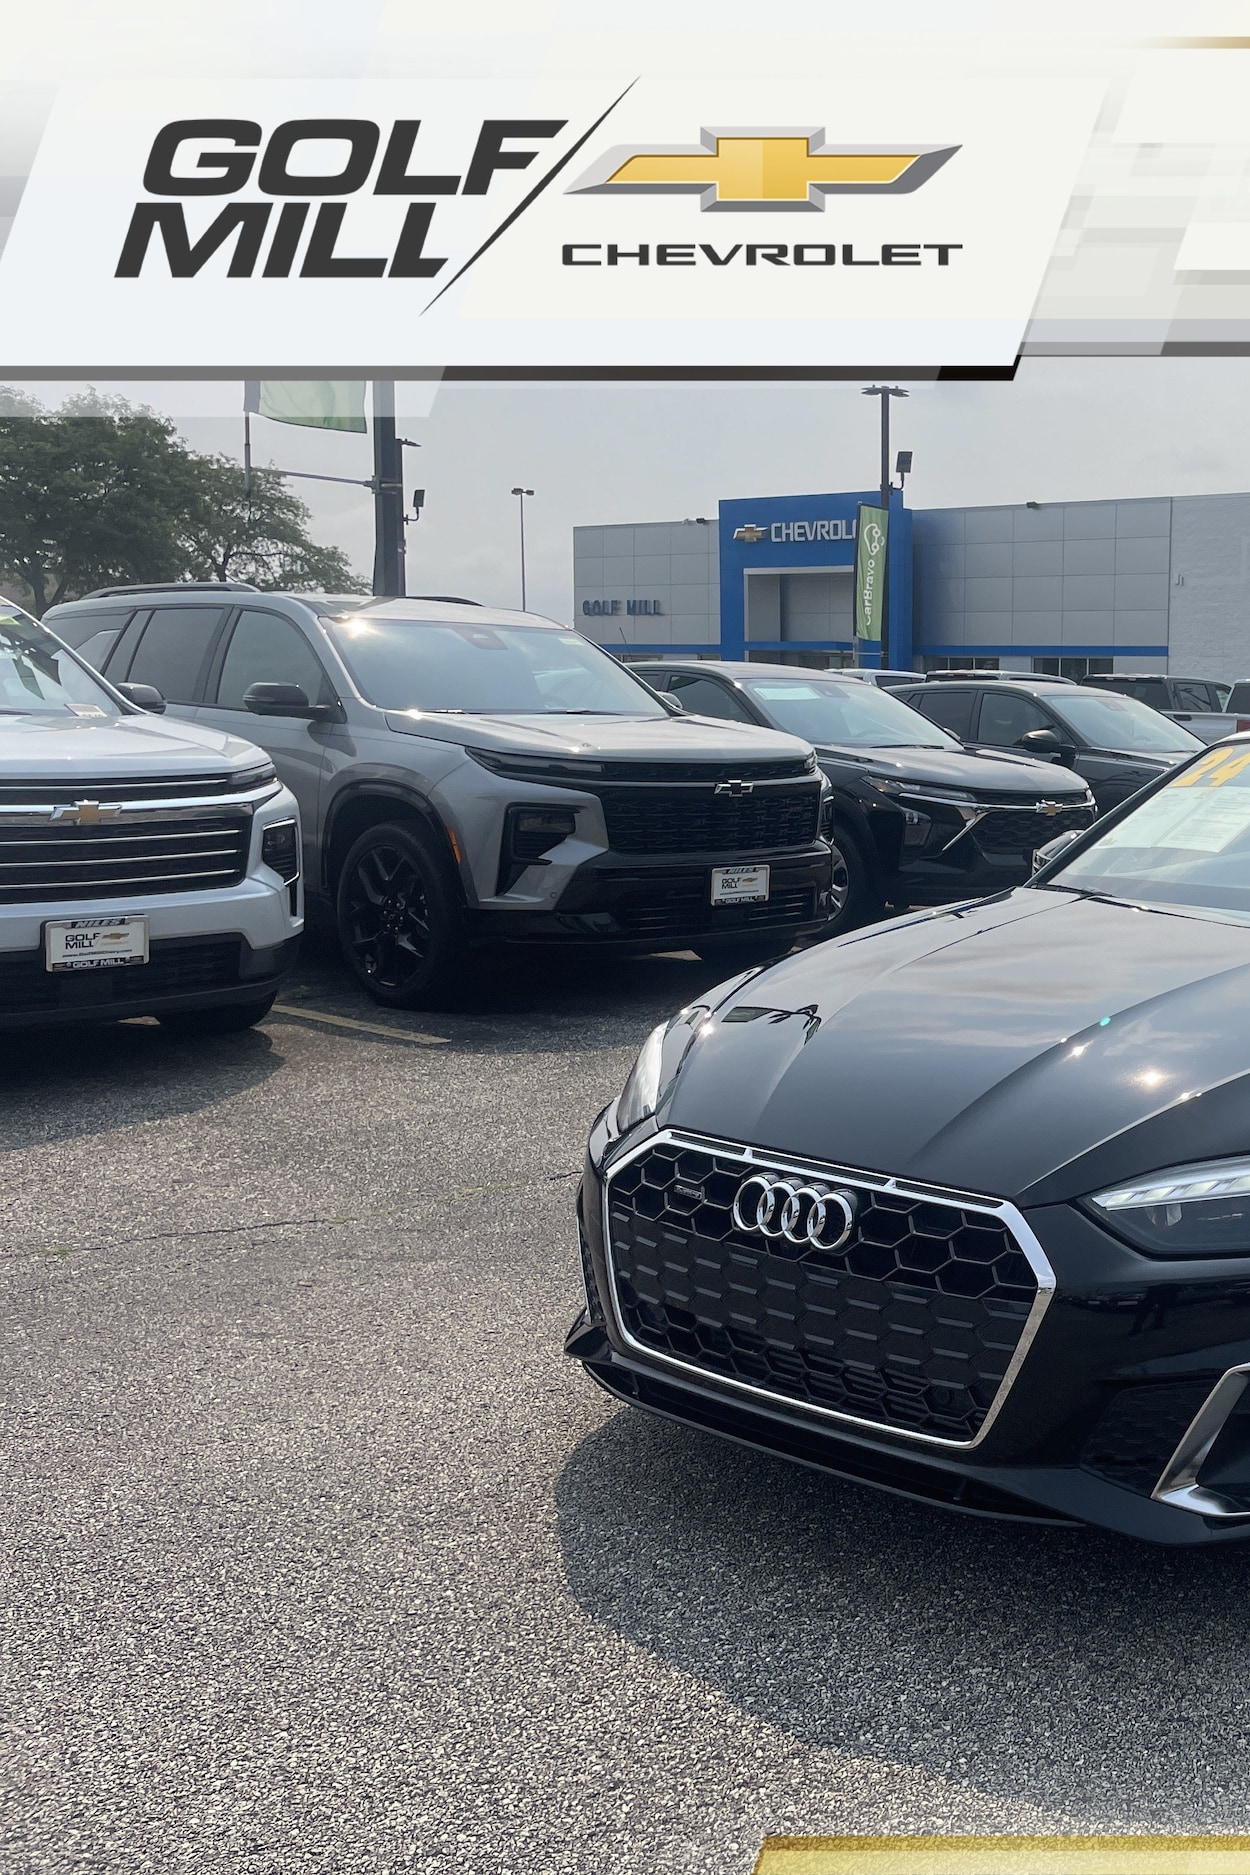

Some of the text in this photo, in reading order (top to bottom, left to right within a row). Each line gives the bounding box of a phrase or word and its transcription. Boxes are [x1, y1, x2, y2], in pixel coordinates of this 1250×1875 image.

[770, 519, 857, 542] CHEVROL
[582, 600, 662, 616] GOLF MILL
[65, 933, 101, 942] GOLF
[65, 941, 94, 949] MILL
[72, 957, 124, 968] GOLF MILL
